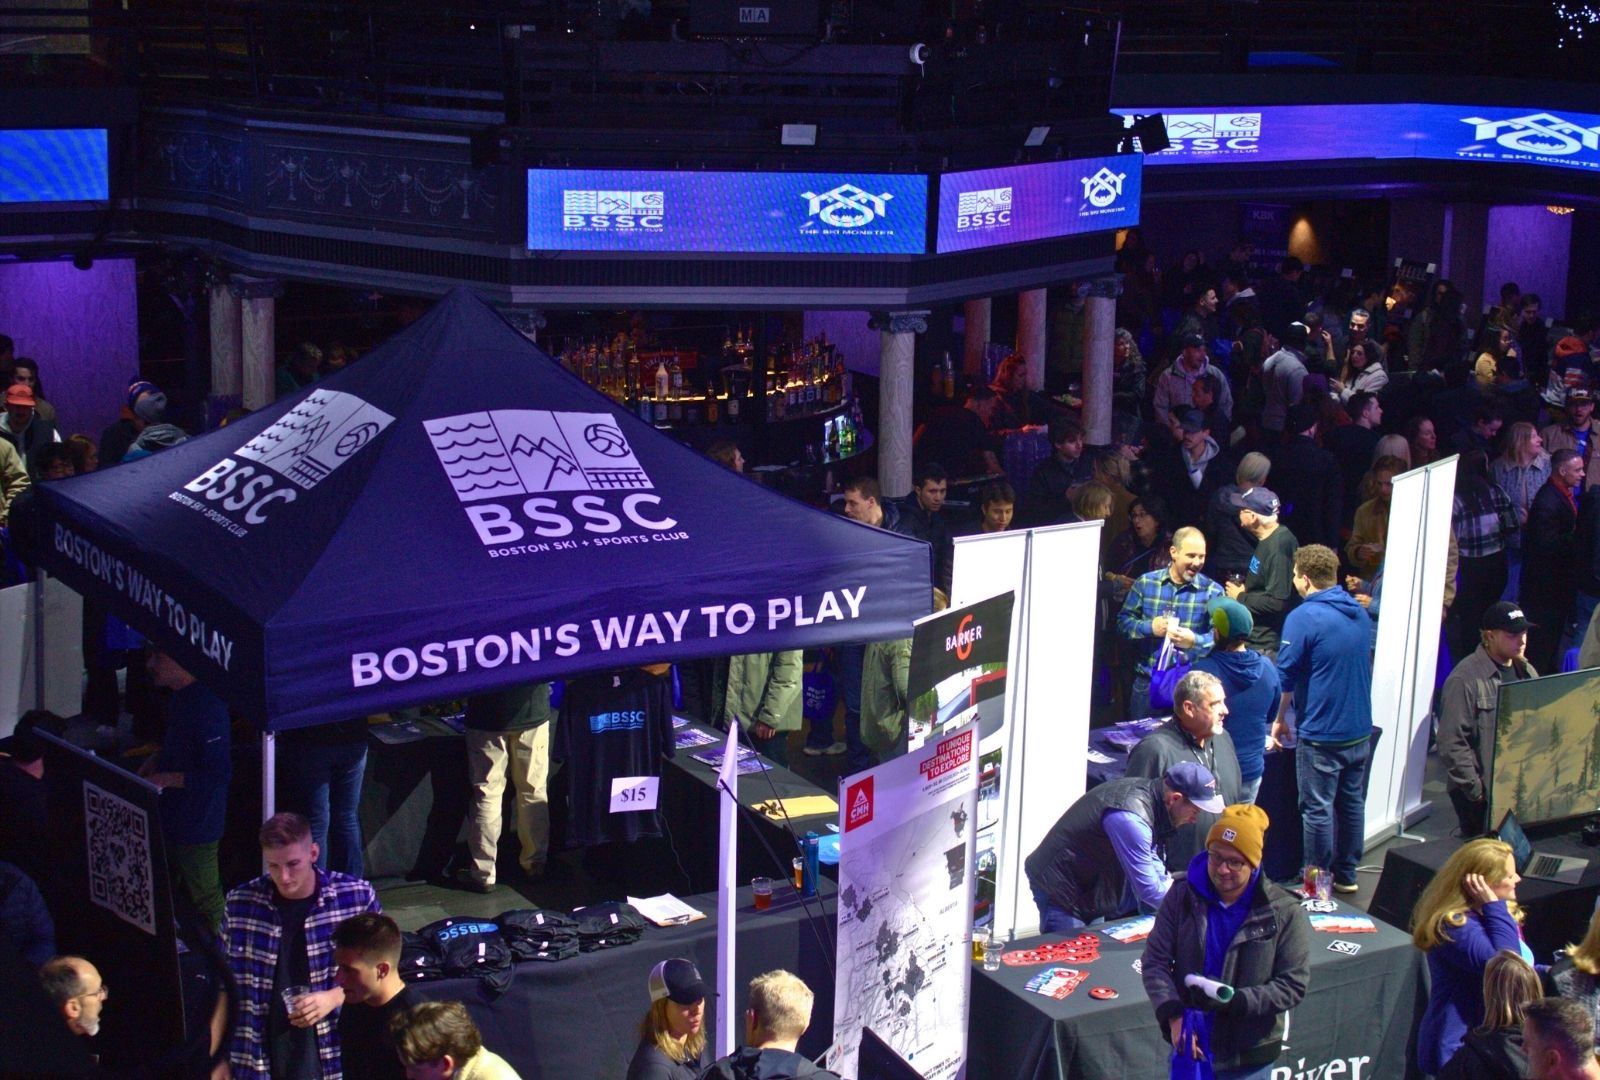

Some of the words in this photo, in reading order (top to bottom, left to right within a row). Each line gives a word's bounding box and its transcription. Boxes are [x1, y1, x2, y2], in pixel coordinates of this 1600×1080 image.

[1161, 137, 1259, 152] SSC
[1536, 156, 1599, 168] MONSTE
[563, 215, 664, 228] BSSC
[957, 210, 1011, 229] BSSC
[184, 458, 297, 524] BSSC
[204, 508, 232, 528] SPORTS
[227, 523, 249, 538] CLUB
[464, 493, 677, 546] BSSC
[488, 542, 550, 558] BOSTON
[552, 539, 578, 550] SKI
[593, 534, 649, 547] SPORTS
[652, 531, 689, 542] CLUB
[54, 522, 125, 591] BOSTON'S
[127, 565, 163, 617] WAY
[165, 594, 187, 636] TO
[190, 613, 233, 672] PLAY
[351, 623, 581, 687] BOSTON'S
[591, 609, 690, 651] WAY
[701, 603, 756, 638] TO
[767, 586, 867, 631] PLAY
[945, 625, 982, 652] BARKER
[611, 711, 645, 723] BSSC
[945, 732, 970, 751] UNIQUE
[922, 743, 970, 771] DESTINATIONS
[930, 766, 940, 777] TO
[940, 752, 969, 773] EXPLORE
[620, 787, 646, 803] $15
[851, 802, 869, 819] CMH
[438, 925, 479, 940] BSSC
